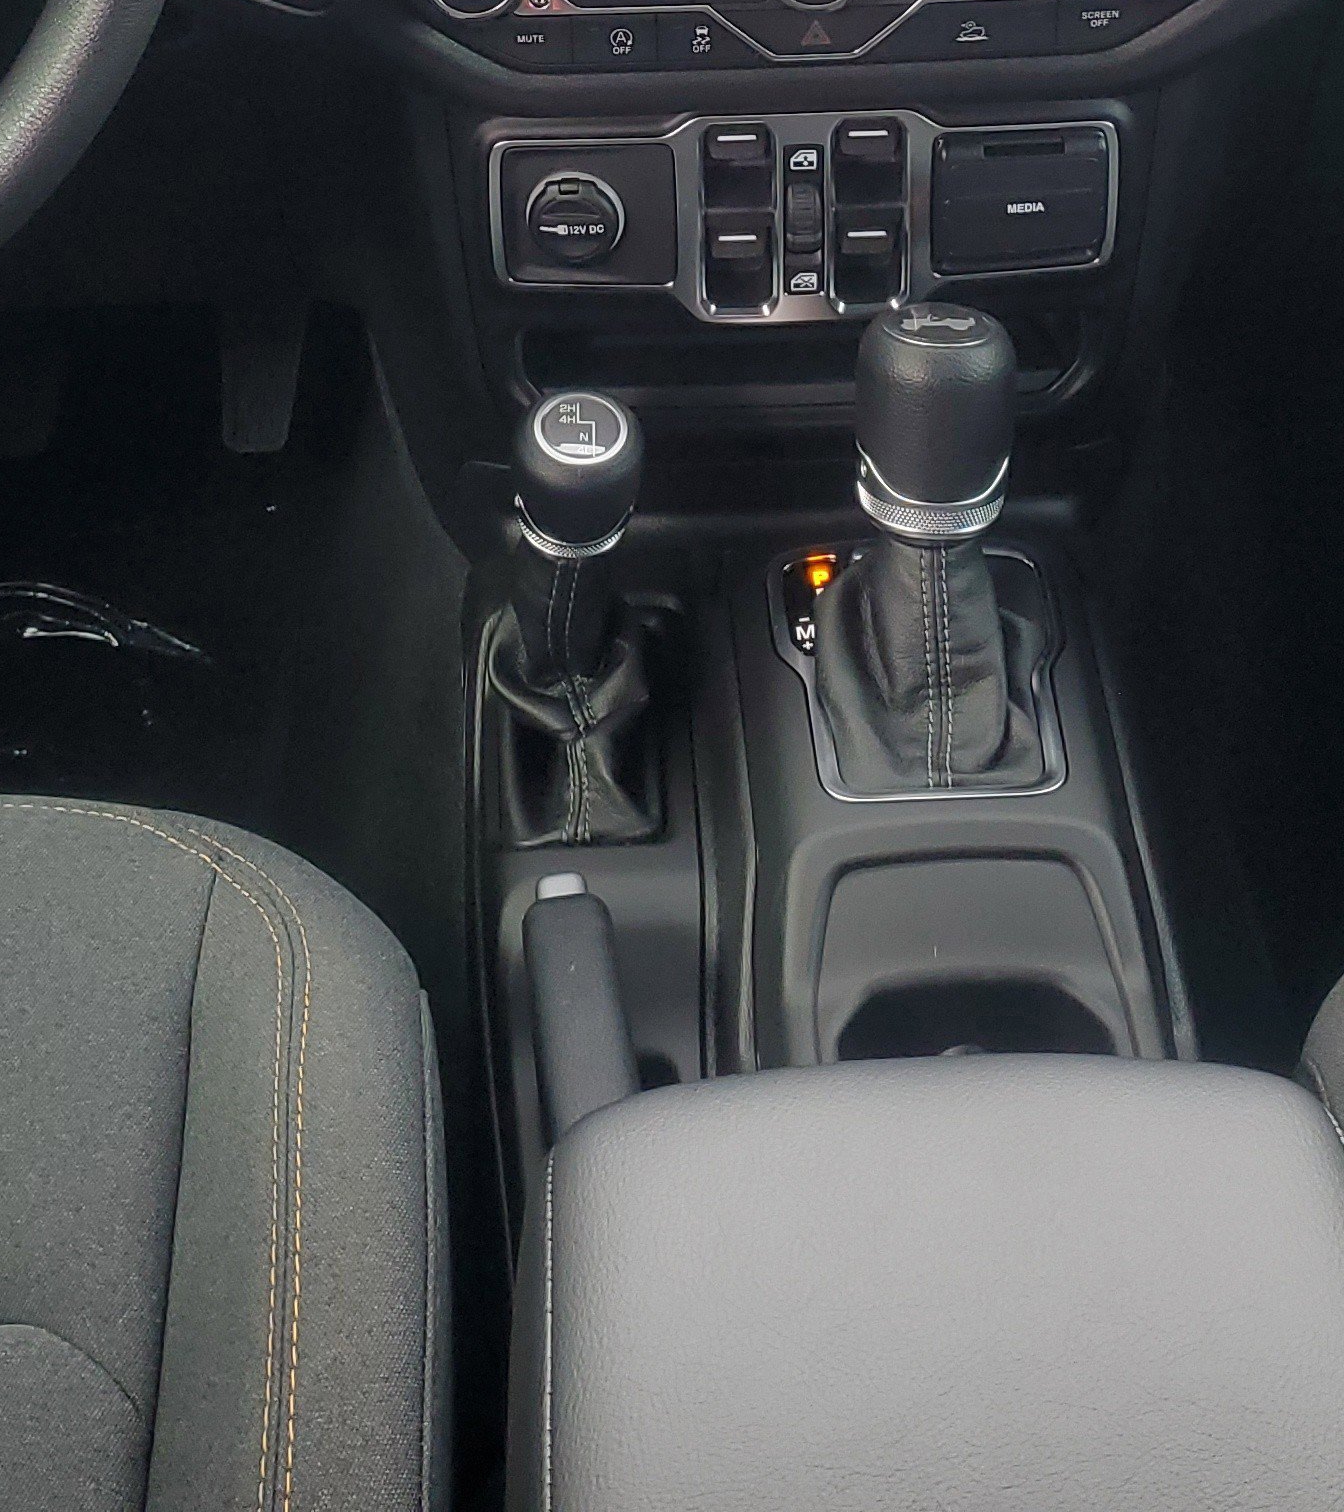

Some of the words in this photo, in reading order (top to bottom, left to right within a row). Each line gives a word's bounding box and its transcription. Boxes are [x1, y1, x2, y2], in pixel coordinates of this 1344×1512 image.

[1081, 10, 1119, 19] SCREEN
[1090, 19, 1109, 28] OFF
[517, 35, 545, 43] MUTE
[613, 47, 631, 55] OFF
[693, 44, 711, 53] OFF
[1007, 201, 1045, 214] MEDIA
[569, 224, 587, 235] 12V
[588, 222, 605, 234] DC
[559, 403, 576, 413] 2H
[559, 415, 576, 424] 4H
[579, 432, 589, 442] N
[812, 571, 829, 586] P
[796, 624, 815, 640] M
